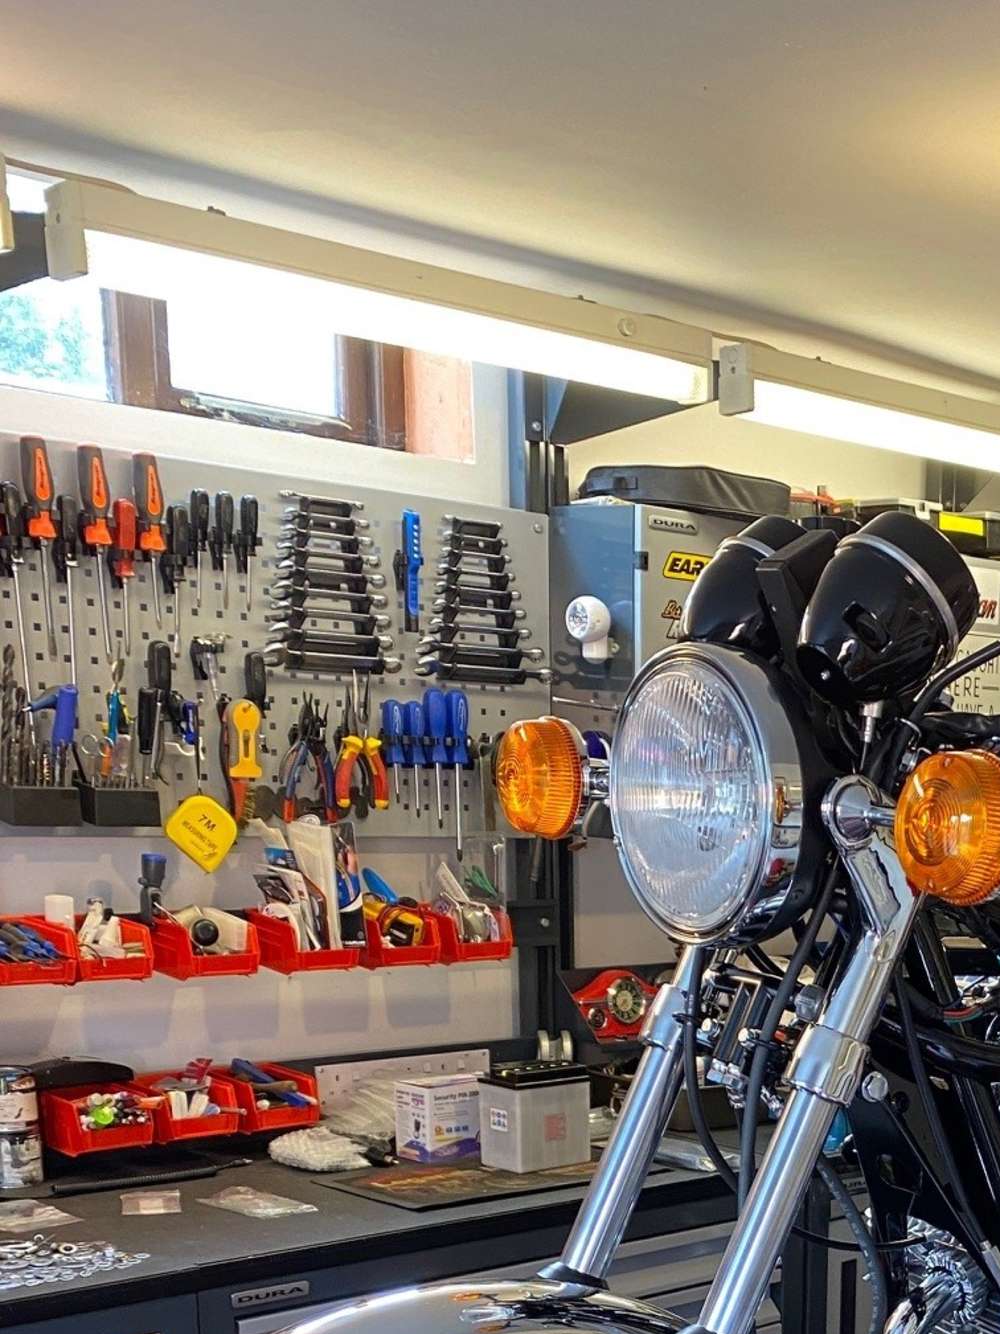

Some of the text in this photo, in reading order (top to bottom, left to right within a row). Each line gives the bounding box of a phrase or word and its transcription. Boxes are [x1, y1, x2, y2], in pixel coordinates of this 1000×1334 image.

[653, 518, 696, 531] DURA
[668, 557, 709, 576] EAR
[238, 1286, 304, 1303] DURA
